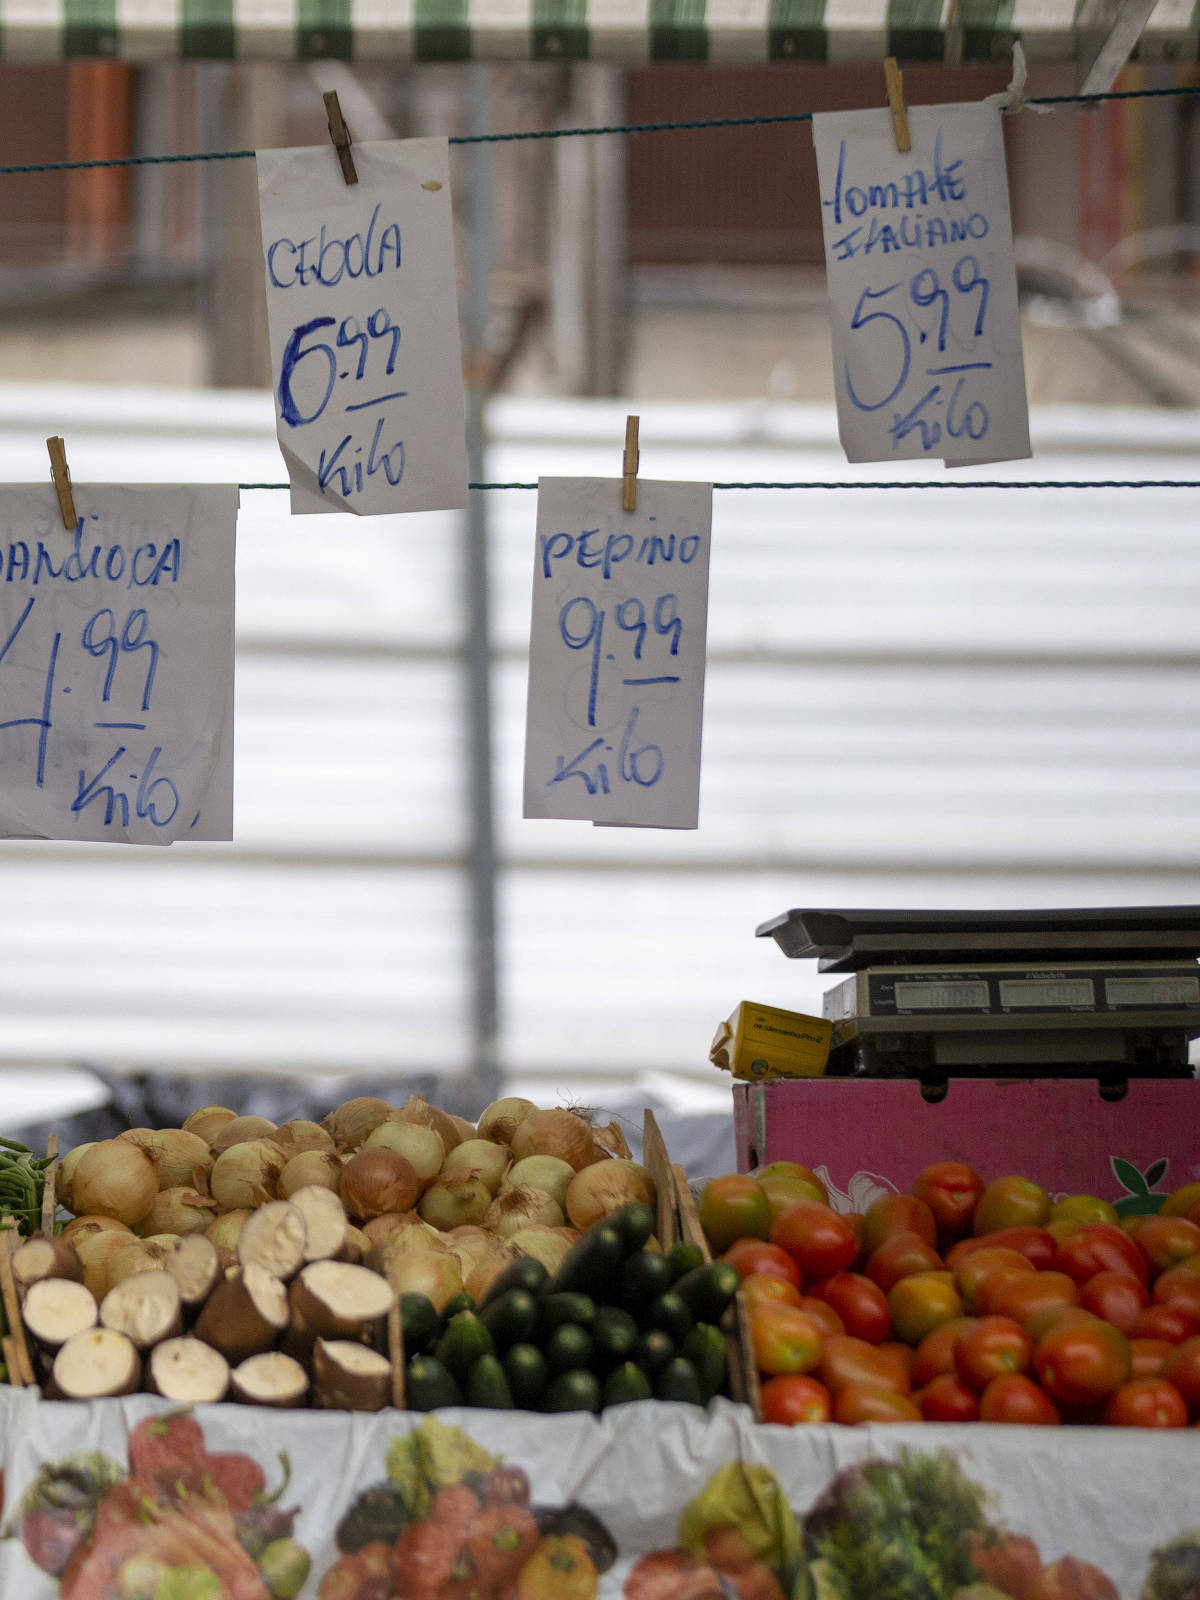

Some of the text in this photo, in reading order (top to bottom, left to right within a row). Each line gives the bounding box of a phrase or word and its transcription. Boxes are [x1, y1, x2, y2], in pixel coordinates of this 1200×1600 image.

[278, 309, 401, 428] 6.99
[845, 254, 990, 412] 5.99
[559, 593, 682, 726] 9.99
